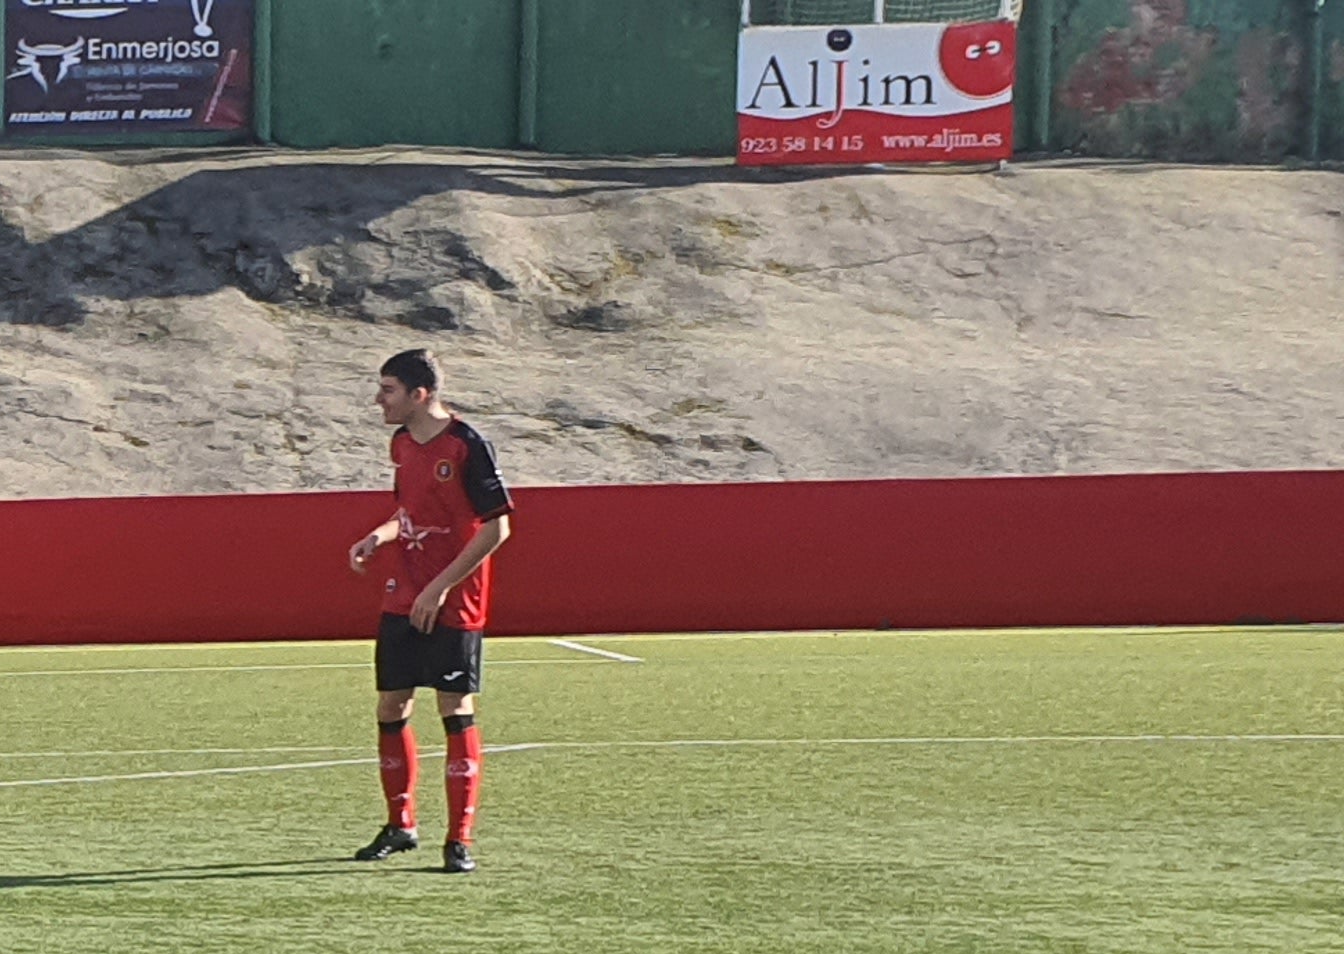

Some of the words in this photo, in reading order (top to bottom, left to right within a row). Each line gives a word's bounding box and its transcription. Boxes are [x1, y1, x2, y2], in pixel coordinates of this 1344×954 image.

[88, 37, 220, 62] Enmerjosa
[740, 138, 777, 154] 923
[782, 136, 805, 152] 58
[813, 136, 834, 151] 14
[841, 134, 864, 151] 15
[882, 128, 1002, 152] www.aljim.es
